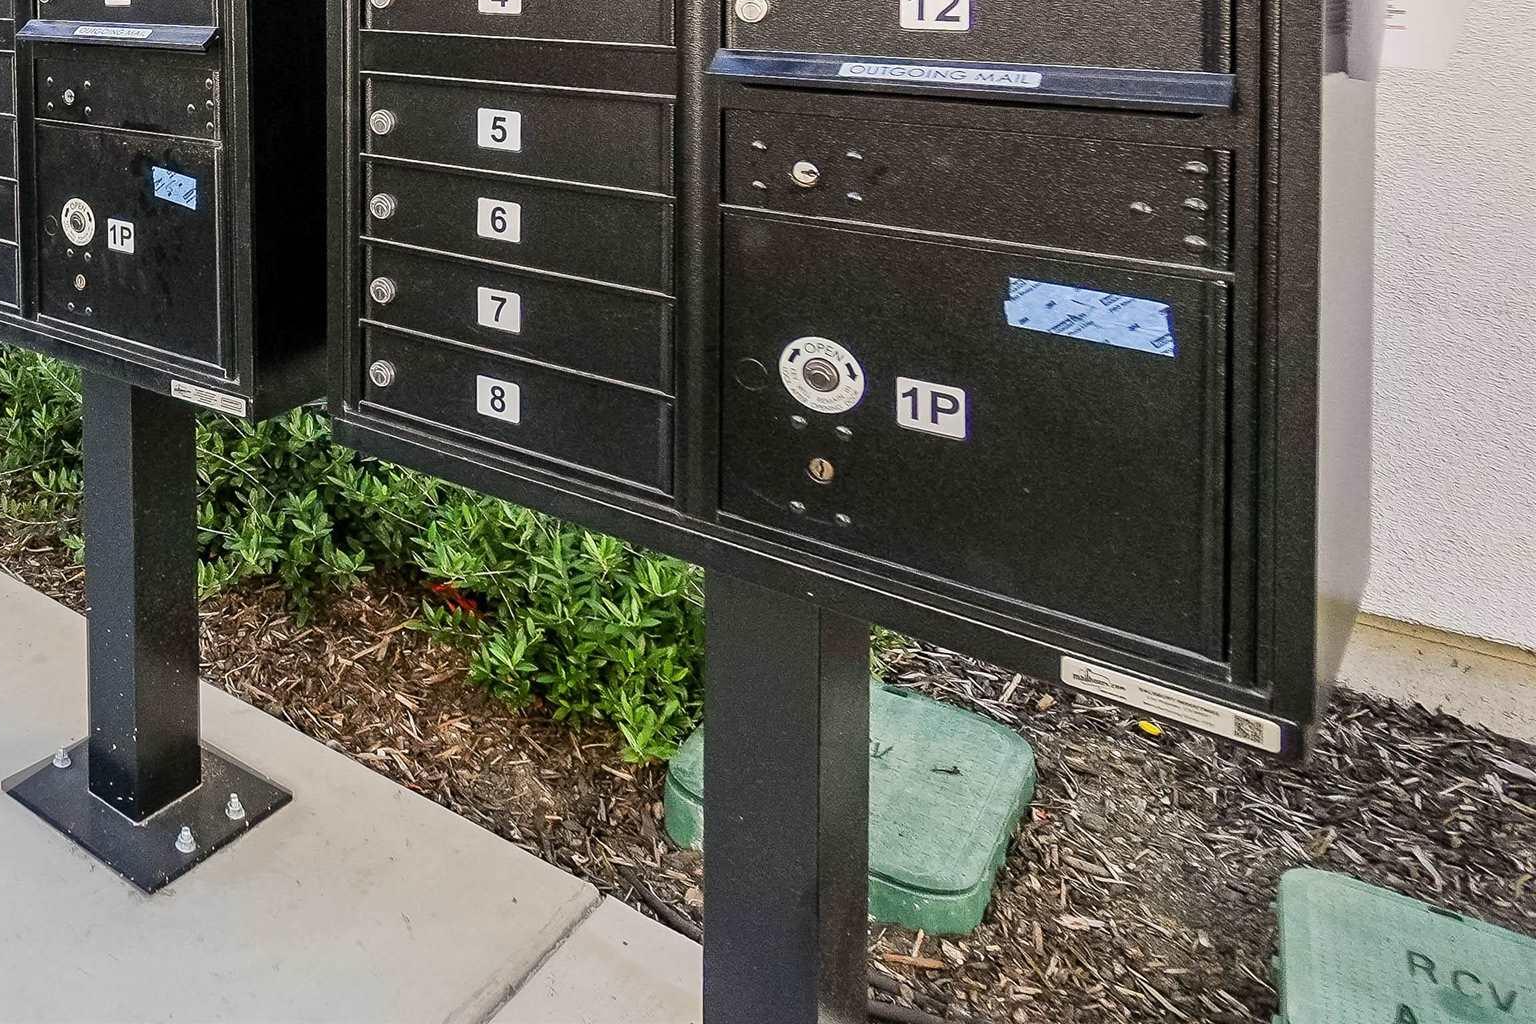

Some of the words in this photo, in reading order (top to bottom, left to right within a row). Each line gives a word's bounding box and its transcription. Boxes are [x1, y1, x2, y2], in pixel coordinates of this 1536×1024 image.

[849, 64, 967, 81] OUTGOING
[974, 72, 1031, 85] MAIL
[490, 115, 507, 143] 5
[70, 202, 86, 212] OPEN
[490, 206, 507, 234] 6
[109, 224, 132, 247] 1P
[490, 295, 507, 323] 7
[804, 342, 845, 364] OPEN
[490, 385, 506, 413] 8
[901, 386, 960, 425] 1P
[1406, 949, 1518, 1012] RCV
